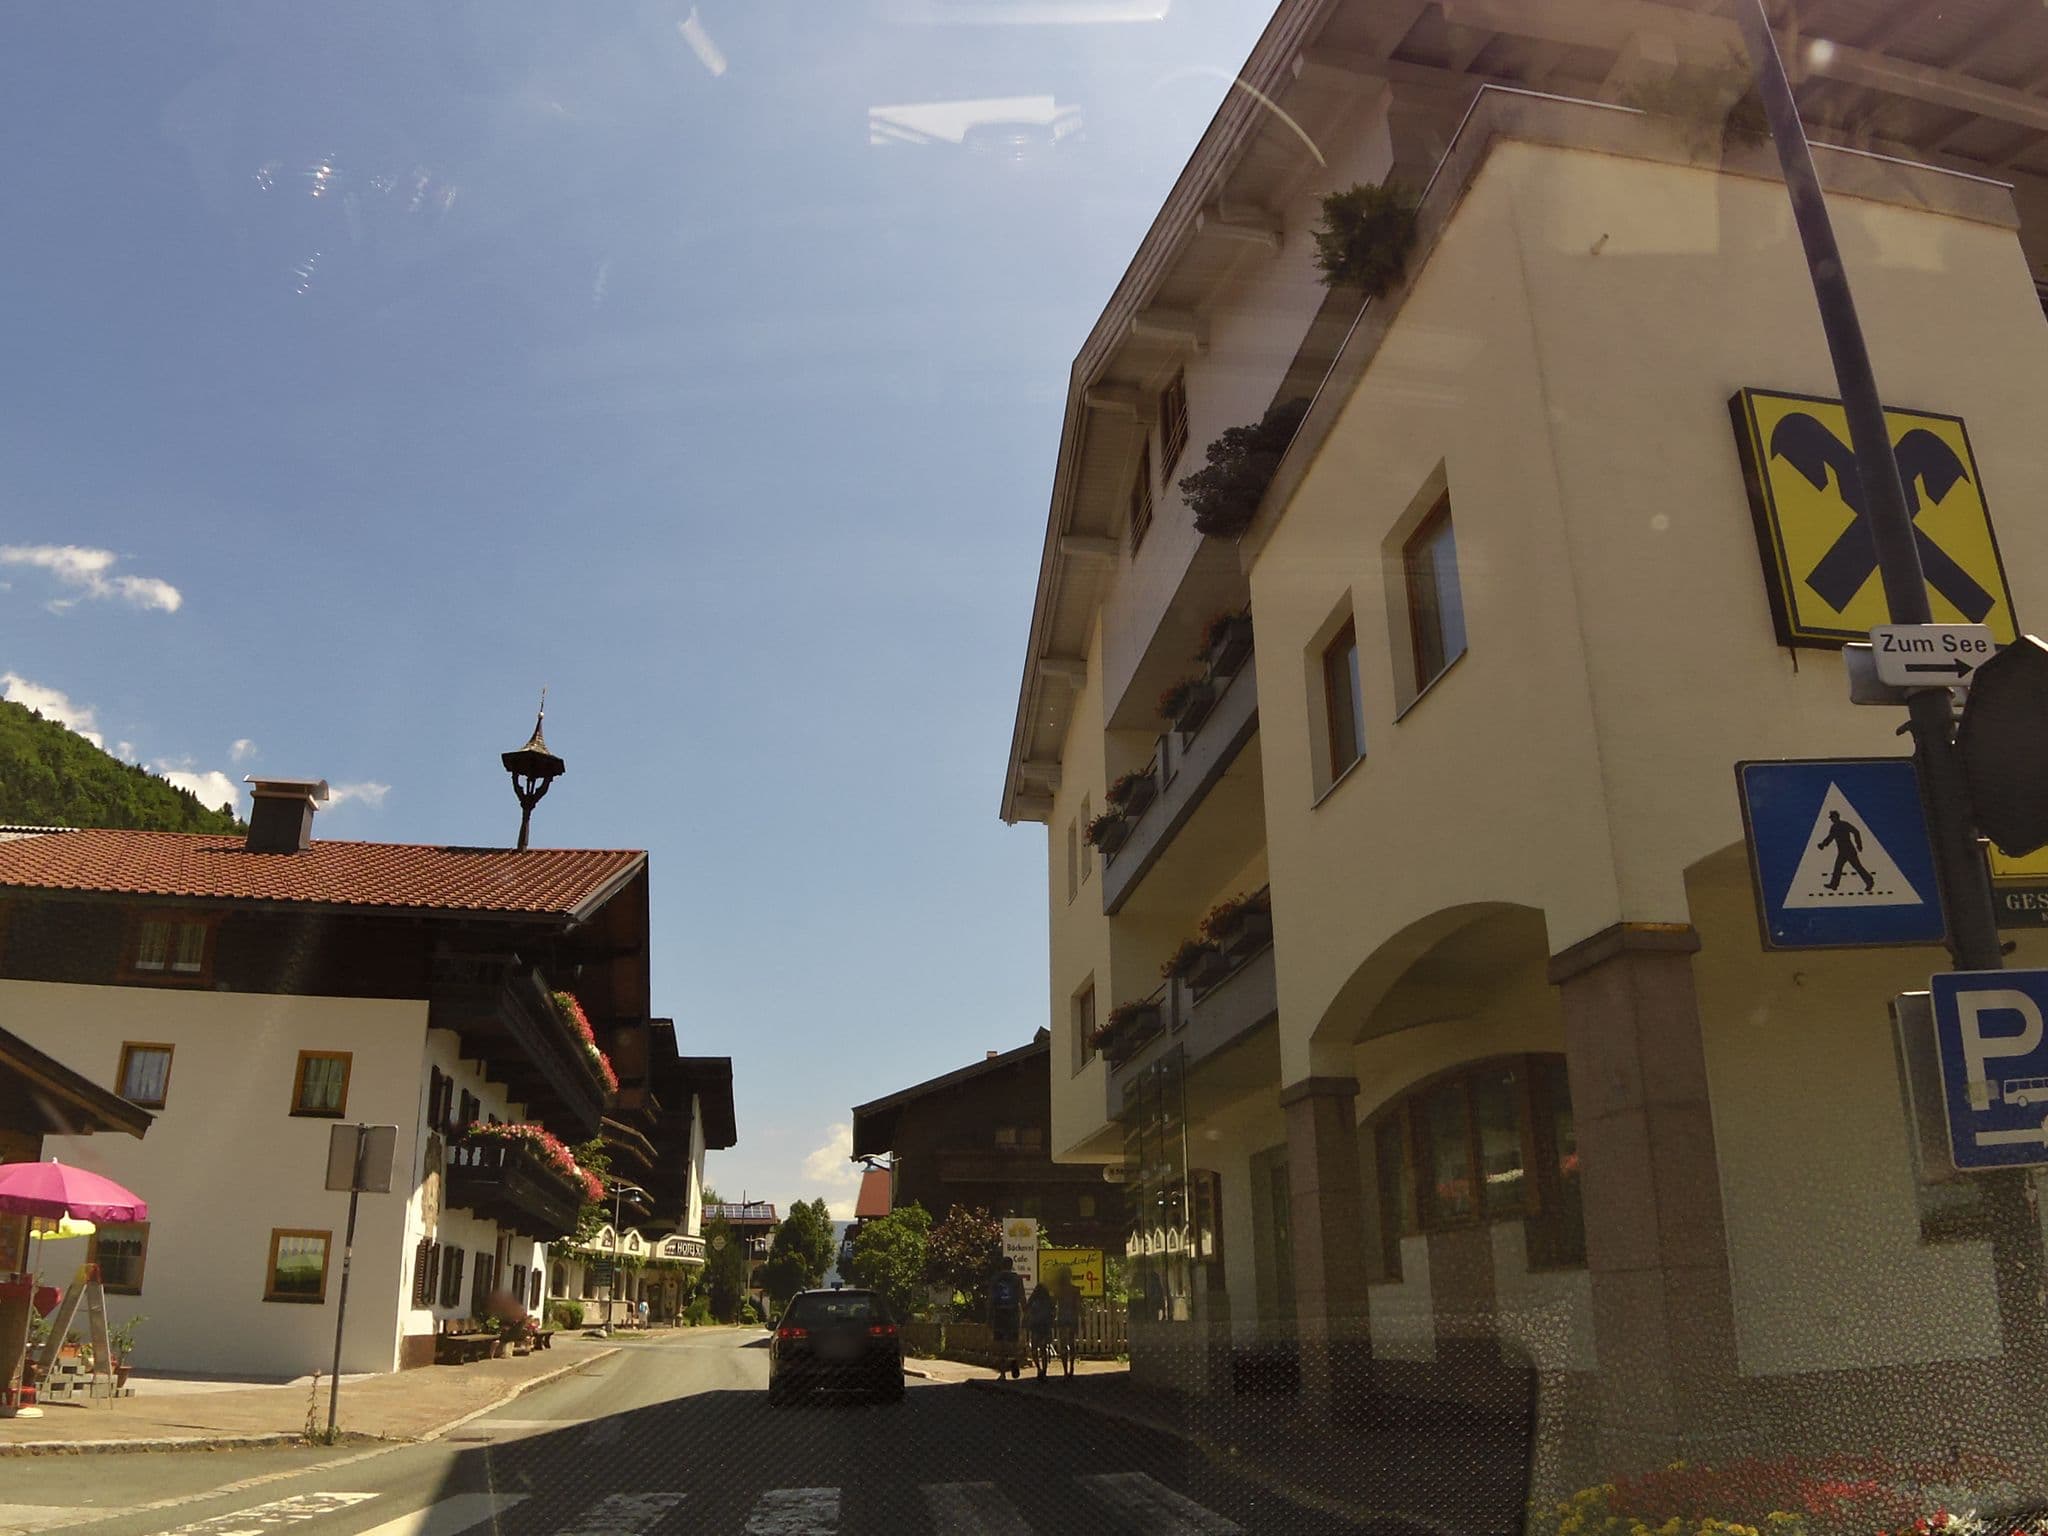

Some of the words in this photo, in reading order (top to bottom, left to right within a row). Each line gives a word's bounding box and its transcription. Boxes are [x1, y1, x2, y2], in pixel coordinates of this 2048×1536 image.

[1880, 634, 1934, 652] Zum
[1942, 634, 1987, 652] See
[1956, 989, 2044, 1111] P
[677, 1242, 696, 1257] HOTEL
